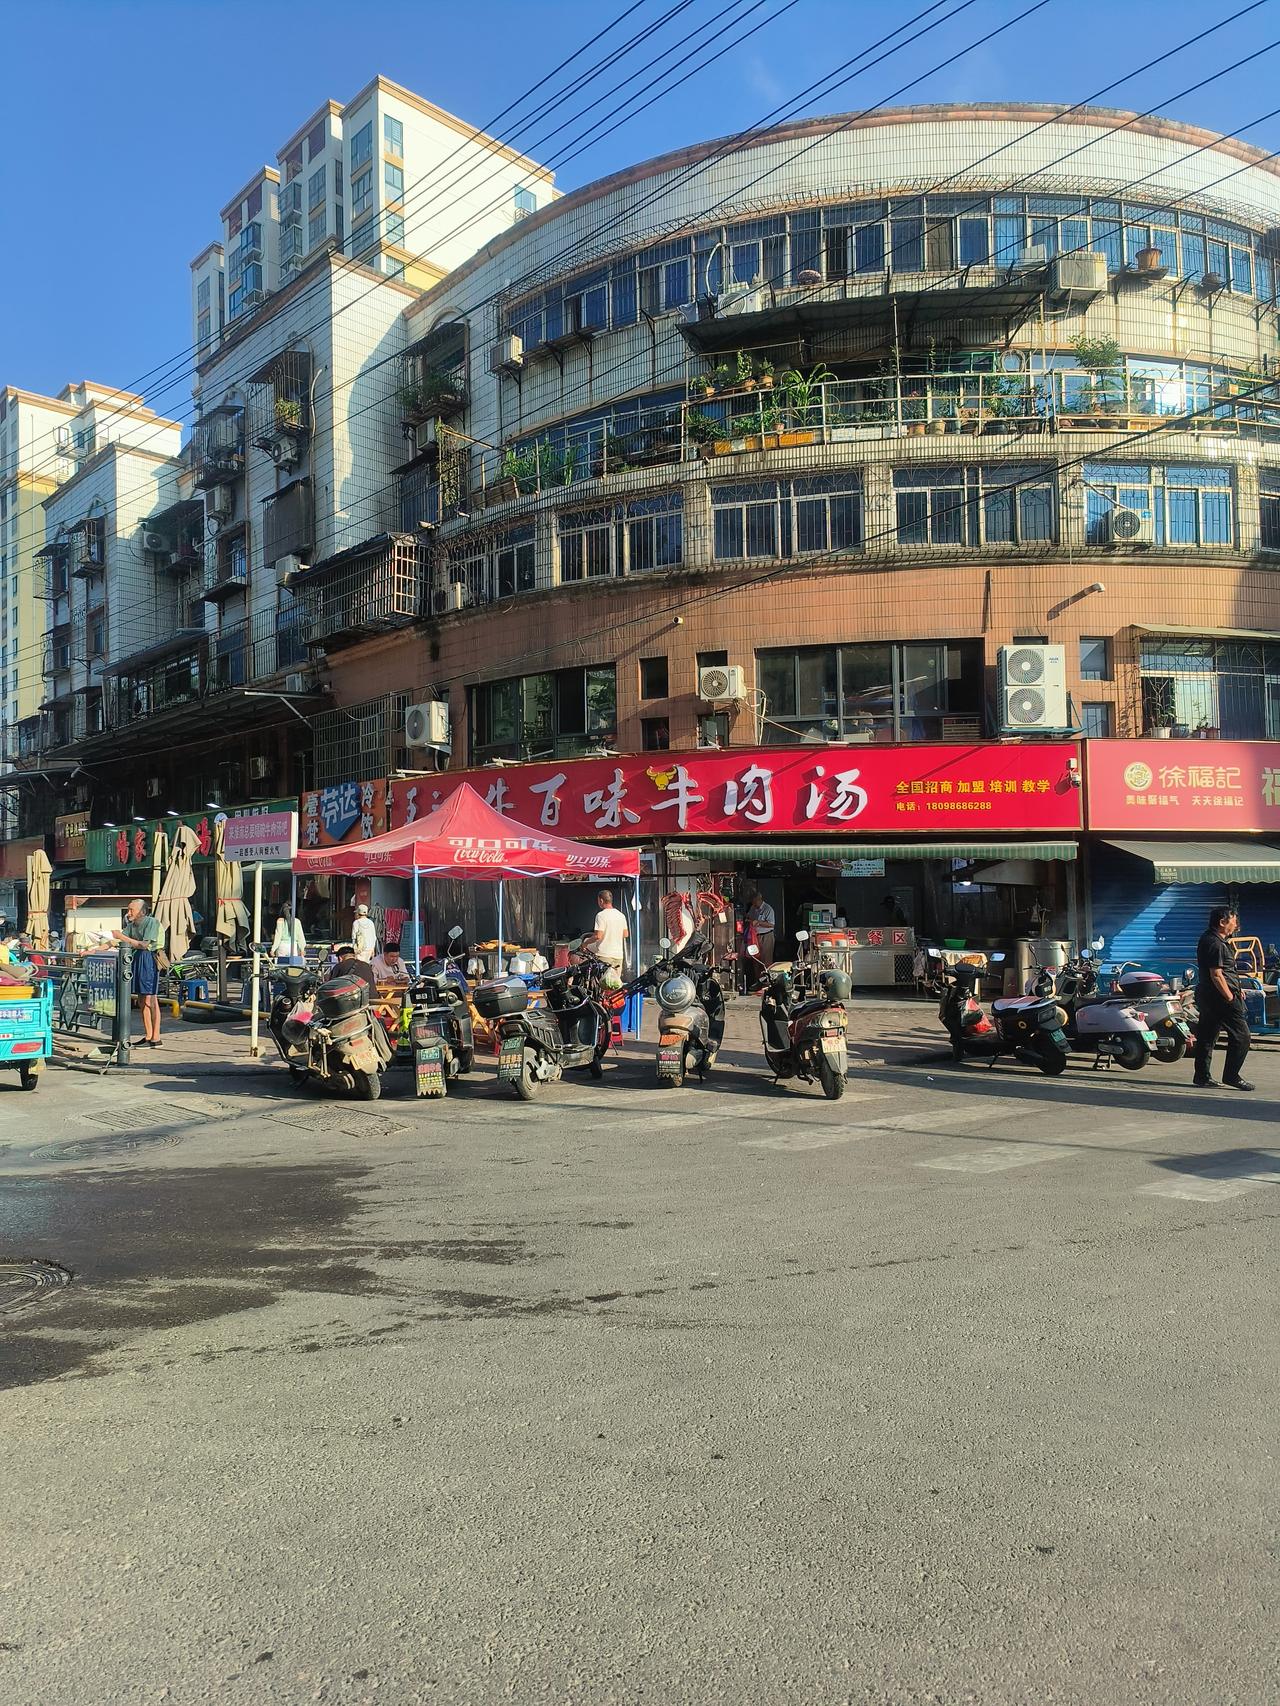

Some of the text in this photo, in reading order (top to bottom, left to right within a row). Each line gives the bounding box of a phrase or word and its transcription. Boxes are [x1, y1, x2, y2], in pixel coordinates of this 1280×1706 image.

[1158, 765, 1242, 788] 徐福記
[896, 779, 1050, 794] 全国招商 加盟 培训 教学
[321, 783, 358, 829] 芬达
[1191, 795, 1244, 807] 天天徐福记
[361, 782, 374, 840] 冷饮
[448, 836, 558, 851] 可口可乐
[847, 929, 908, 945] 点餐区
